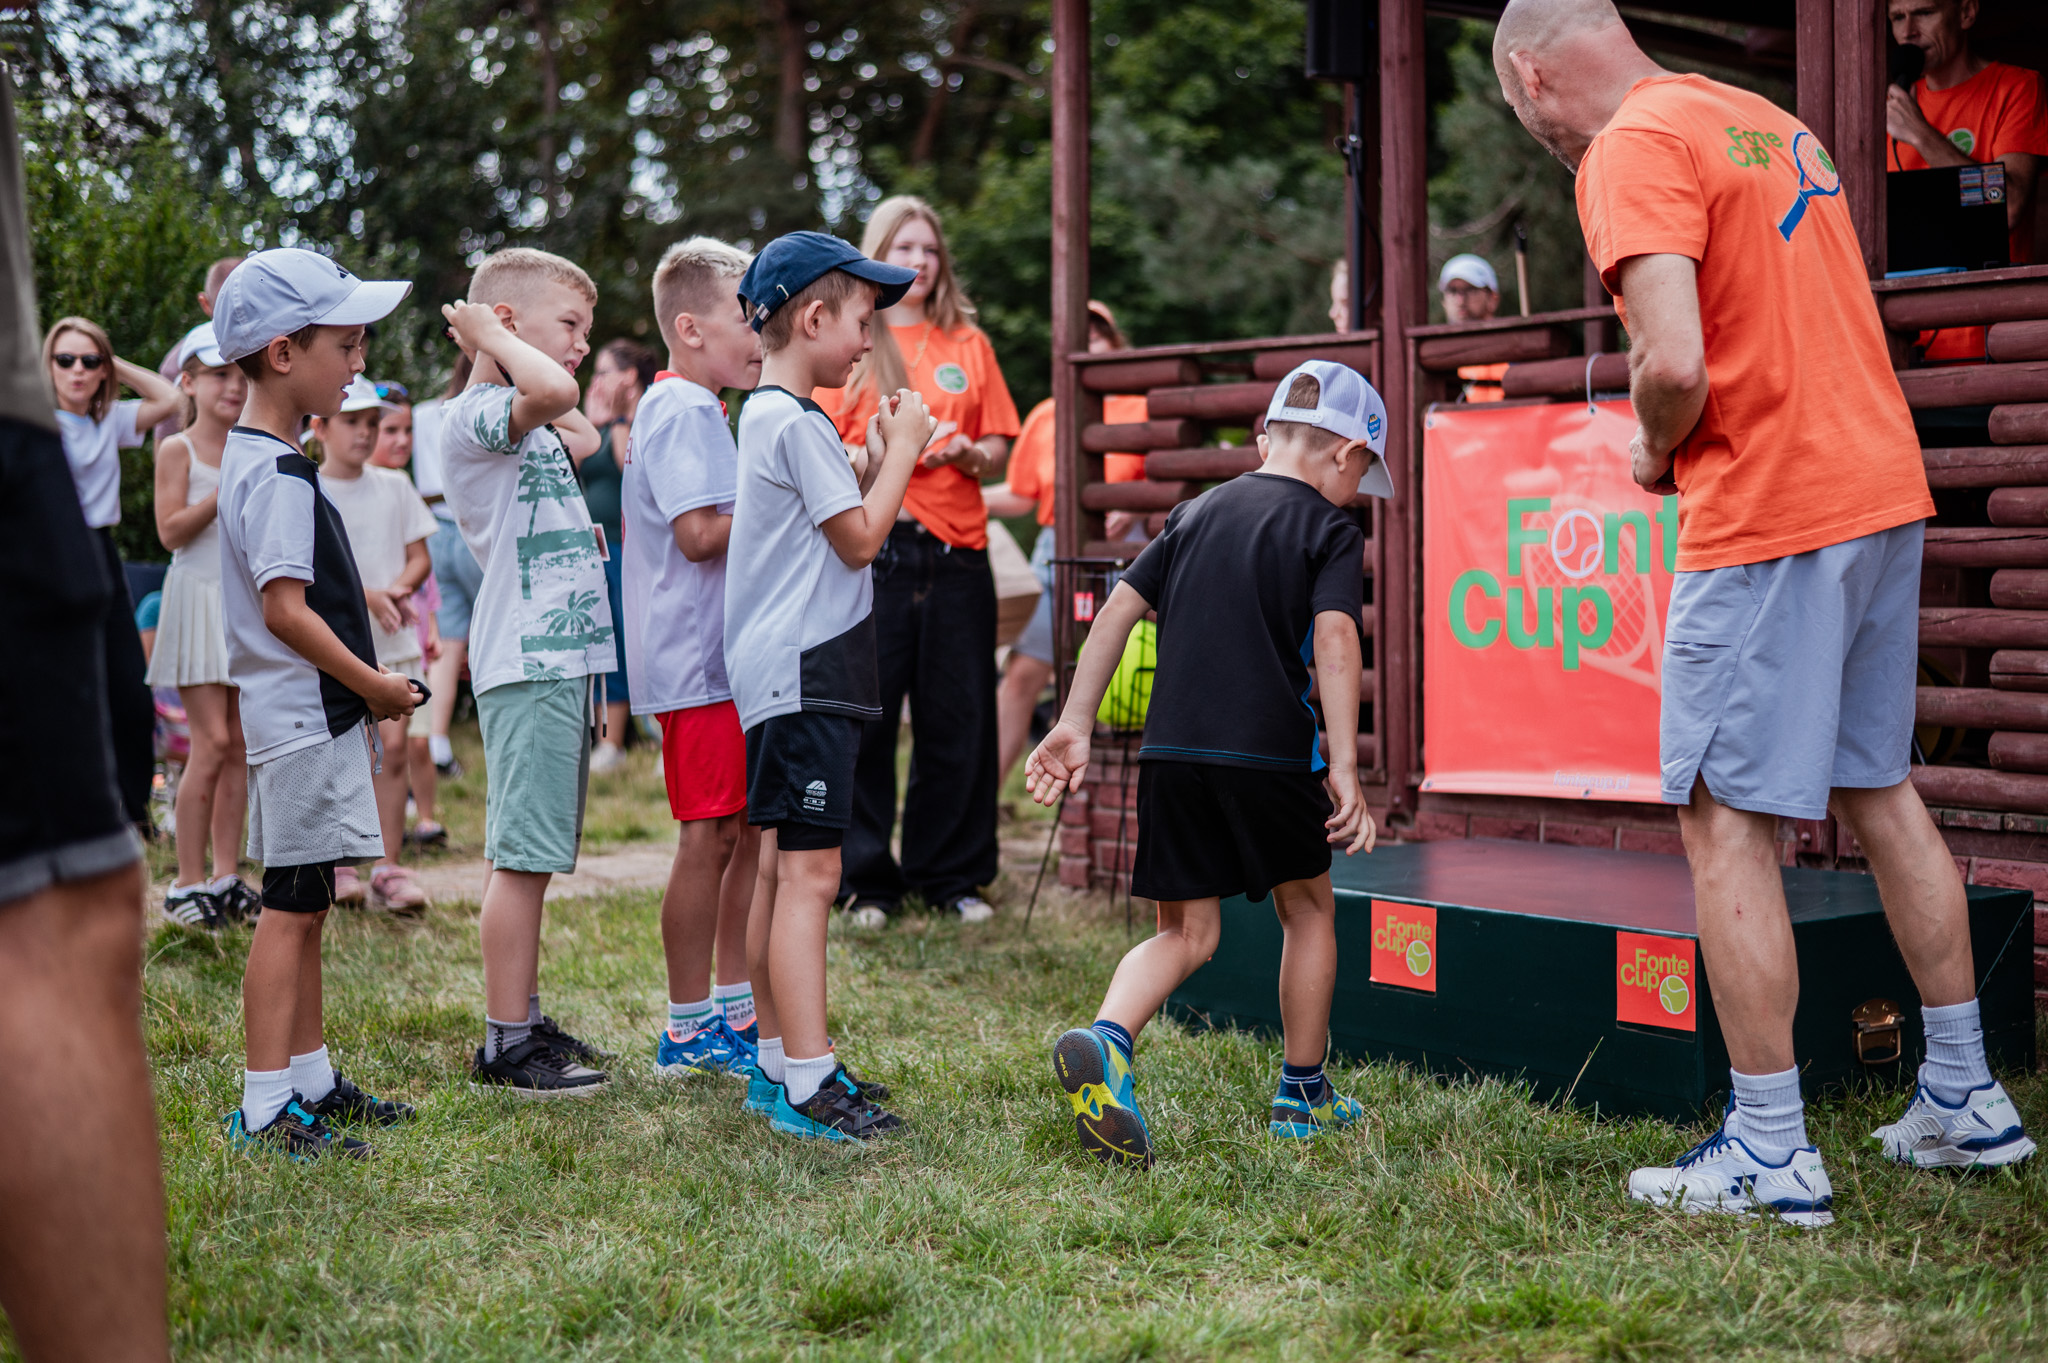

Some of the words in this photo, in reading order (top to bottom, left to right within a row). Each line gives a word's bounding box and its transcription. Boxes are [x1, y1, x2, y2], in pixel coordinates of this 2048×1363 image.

[1724, 126, 1784, 149] Fone
[1727, 146, 1770, 170] Cup
[1448, 569, 1614, 671] Cup
[1374, 928, 1407, 957] Cup
[1386, 915, 1432, 942] Fonte
[1635, 948, 1690, 976] Fonte
[1620, 962, 1660, 993] Cup
